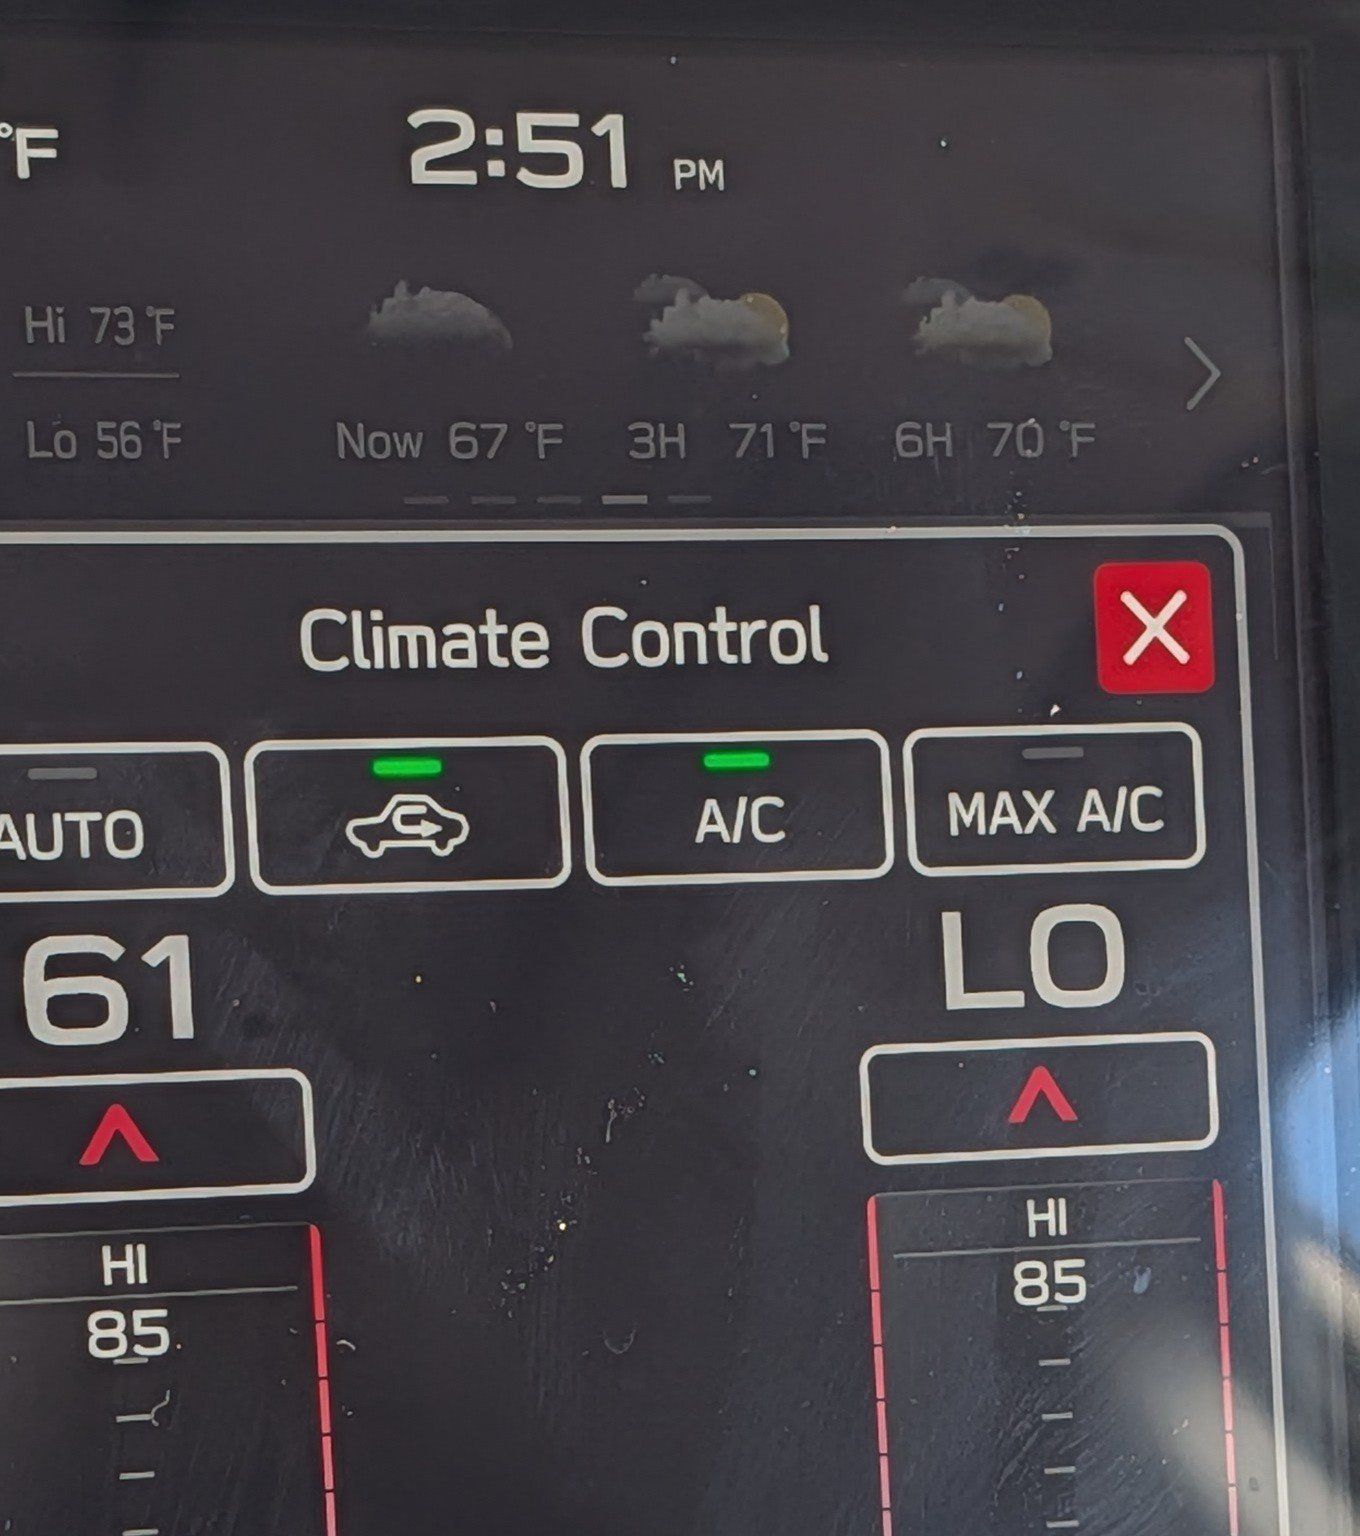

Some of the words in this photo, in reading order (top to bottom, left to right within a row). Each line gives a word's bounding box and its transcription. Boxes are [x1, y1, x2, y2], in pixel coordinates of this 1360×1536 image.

[406, 108, 627, 189] 2:51
[673, 158, 725, 191] PM
[24, 305, 66, 344] Hi
[26, 420, 77, 459] Lo
[336, 421, 424, 460] Now
[627, 421, 686, 459] 3H
[895, 421, 953, 458] 6H
[300, 608, 550, 672] Climate
[581, 604, 829, 668] Control
[695, 795, 786, 844] A/C
[947, 789, 1057, 837] MAX
[1076, 785, 1164, 833] A/C
[941, 903, 1126, 1011] LO
[22, 934, 195, 1046] 61
[1026, 1197, 1068, 1238] HI
[101, 1243, 148, 1286] HI
[1013, 1258, 1087, 1305] 85
[87, 1308, 170, 1358] 85
